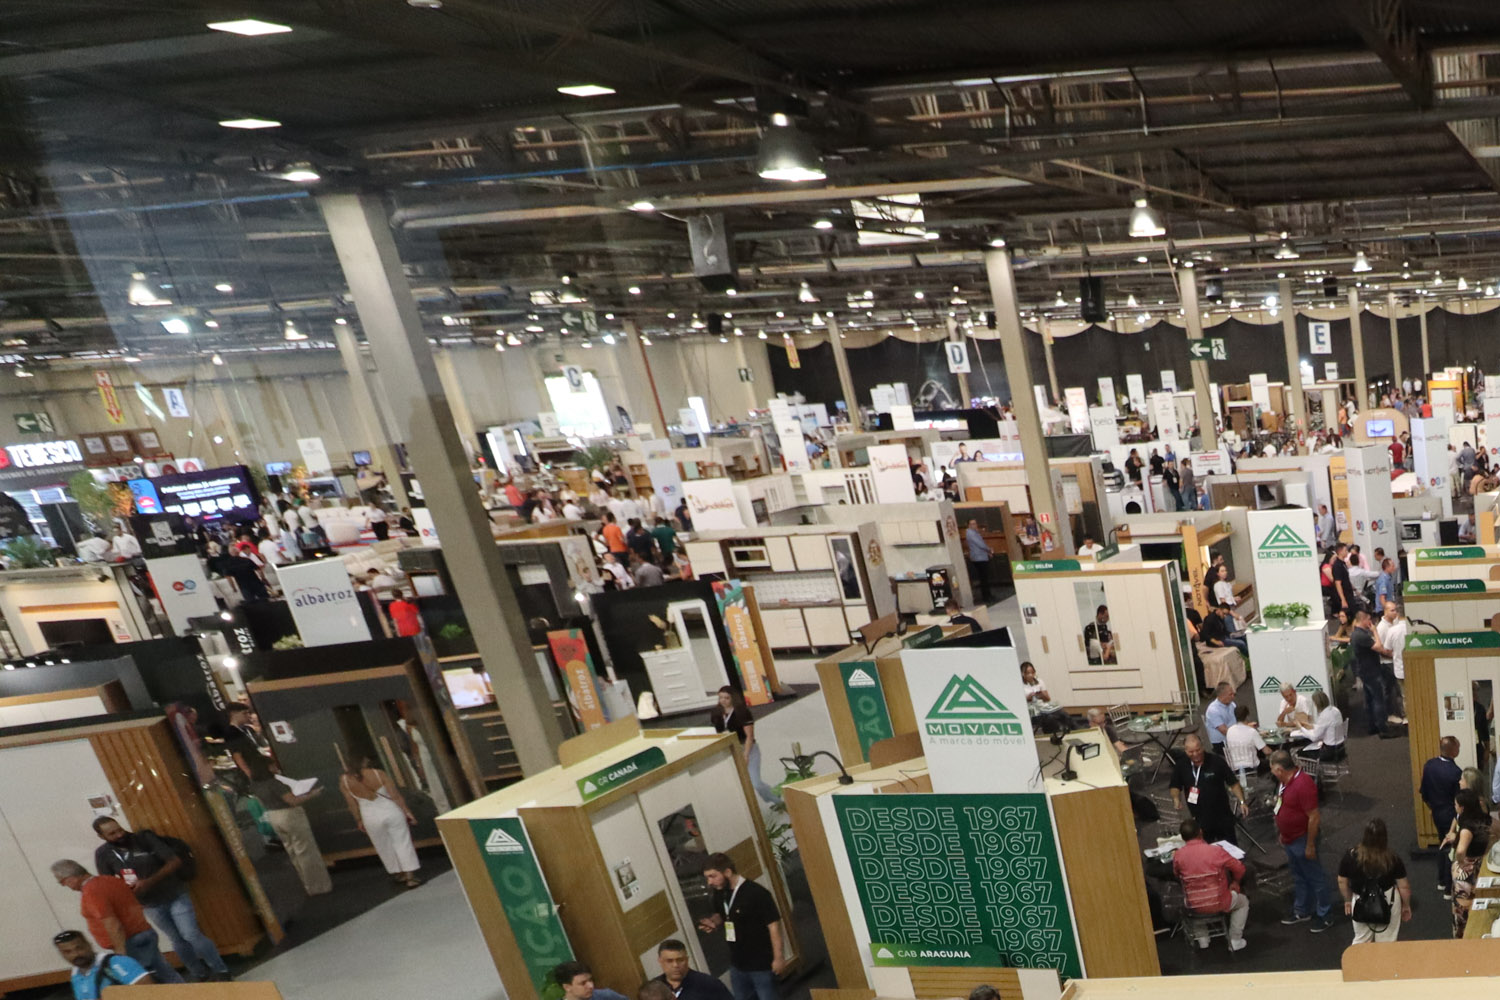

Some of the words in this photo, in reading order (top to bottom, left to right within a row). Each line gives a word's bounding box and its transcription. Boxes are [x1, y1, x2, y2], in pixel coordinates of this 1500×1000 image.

[1314, 324, 1326, 347] E
[951, 344, 963, 365] D
[567, 367, 581, 387] C
[1258, 551, 1312, 559] MOVAL
[295, 588, 353, 607] albatroz
[1437, 637, 1473, 645] VALENÇA
[927, 723, 1021, 735] MOVAL
[975, 736, 989, 745] do
[992, 735, 1026, 745] móvel
[608, 762, 638, 781] CANADÁ
[845, 807, 959, 831] DESDE
[963, 806, 1037, 831] 1967
[852, 832, 964, 856] DESDE
[969, 831, 1042, 855] 1967
[858, 857, 970, 880] DESDE
[975, 856, 1048, 880] 1967
[865, 881, 976, 904] DESDE
[980, 881, 1053, 904] 1967
[871, 905, 981, 928] DESDE
[986, 905, 1058, 928] 1967
[991, 929, 1063, 951] 1967
[897, 950, 917, 958] CAB
[919, 950, 971, 959] ARAGUAIA
